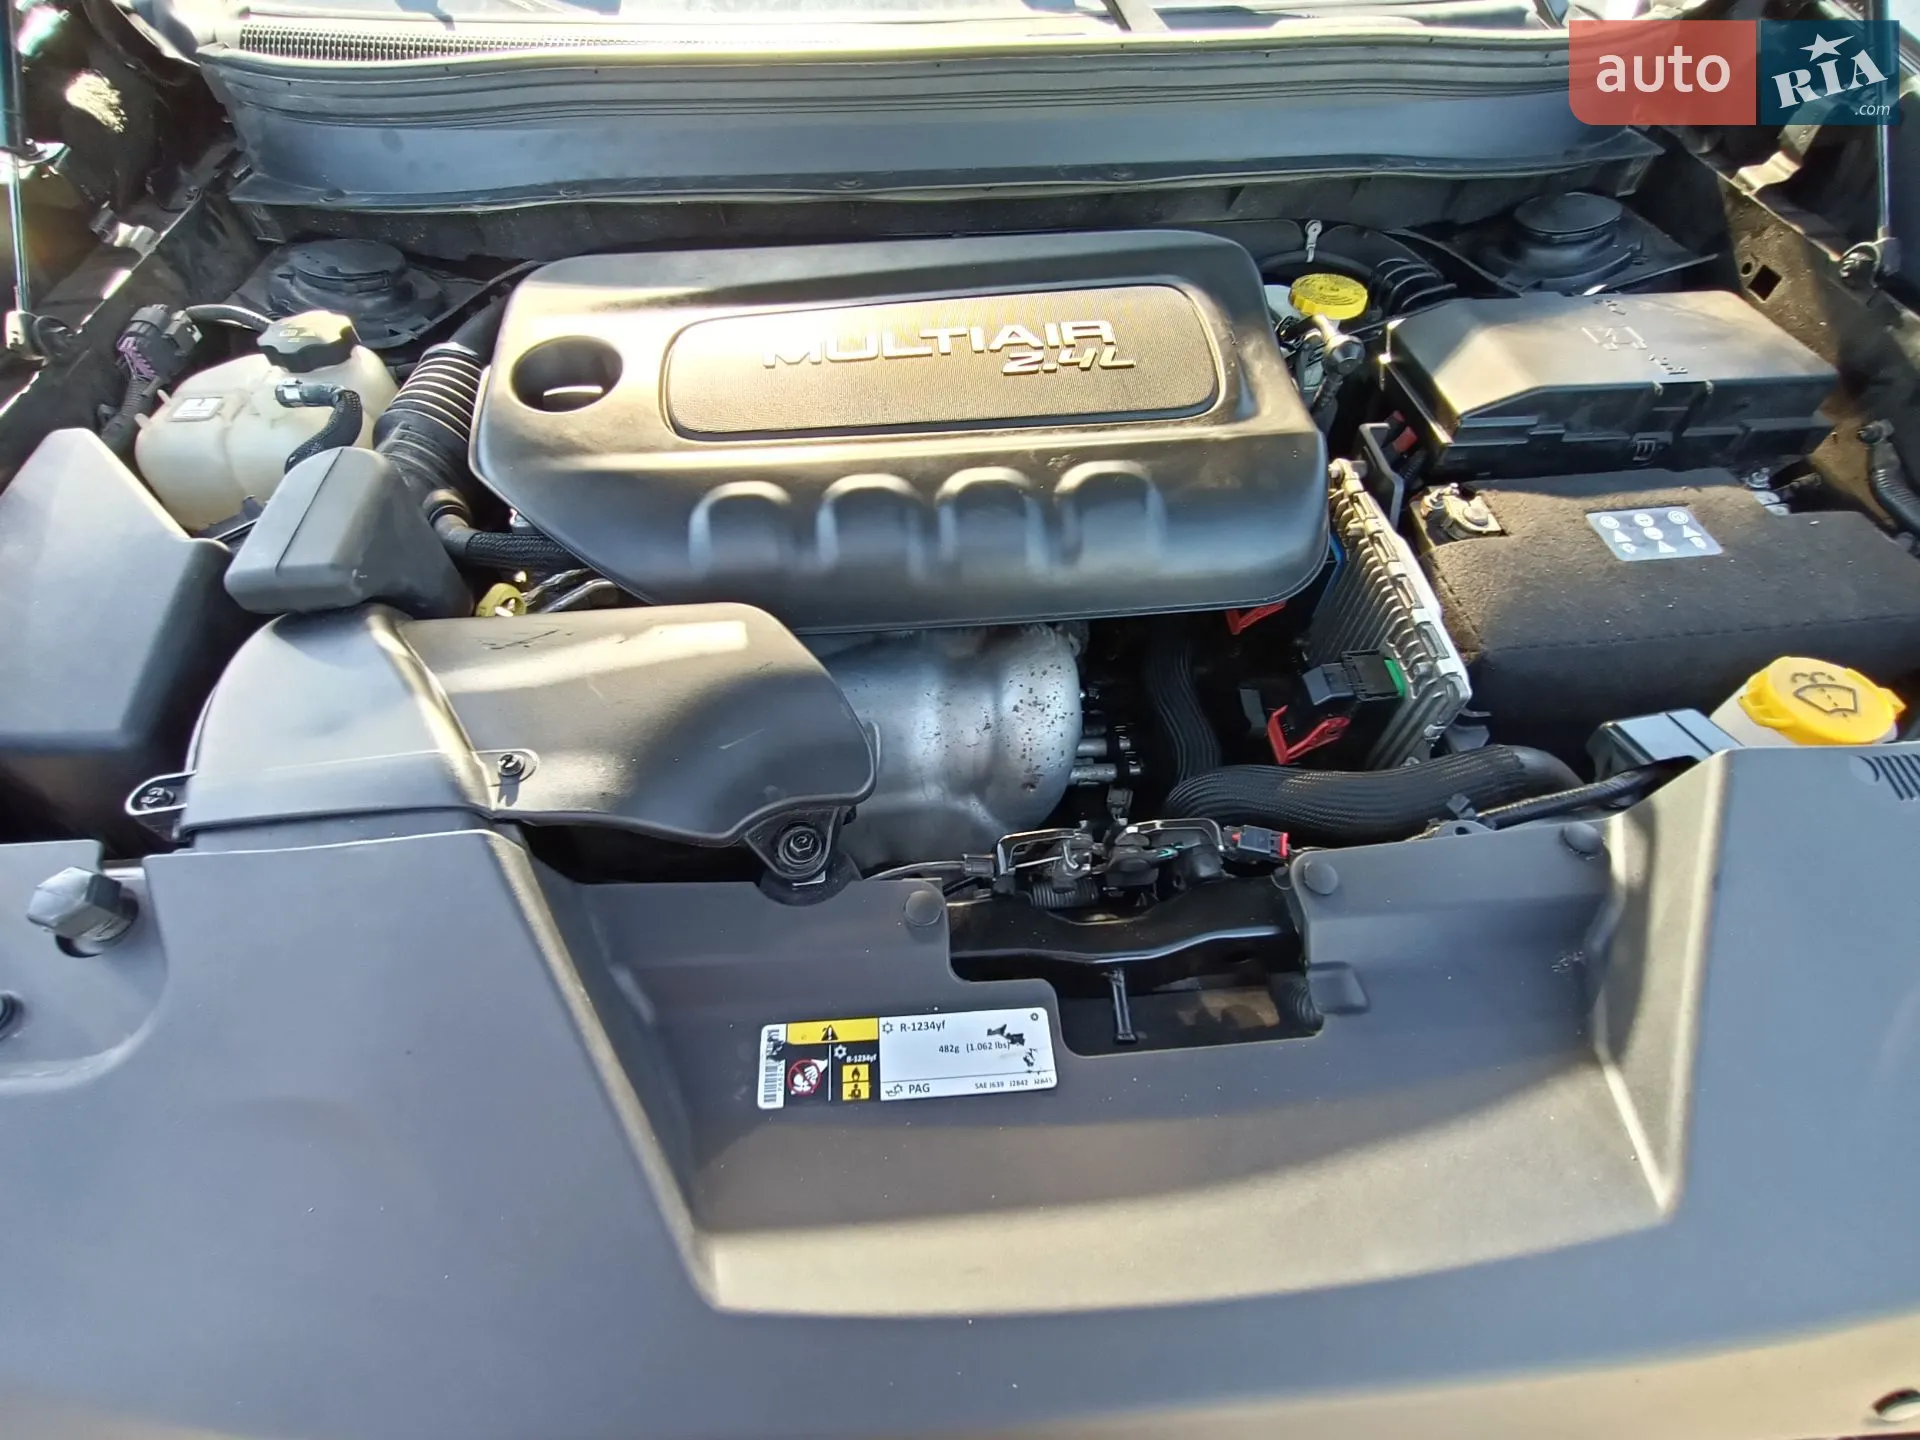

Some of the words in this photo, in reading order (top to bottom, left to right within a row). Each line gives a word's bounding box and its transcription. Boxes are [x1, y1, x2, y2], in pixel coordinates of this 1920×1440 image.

[762, 319, 1116, 368] MULTIAIR
[1002, 346, 1136, 375] 2.4L
[900, 1020, 946, 1033] R-1234yf
[938, 1044, 961, 1054] 482g
[966, 1042, 993, 1054] (1.062
[908, 1083, 931, 1095] PAG
[974, 1081, 988, 1090] SAE
